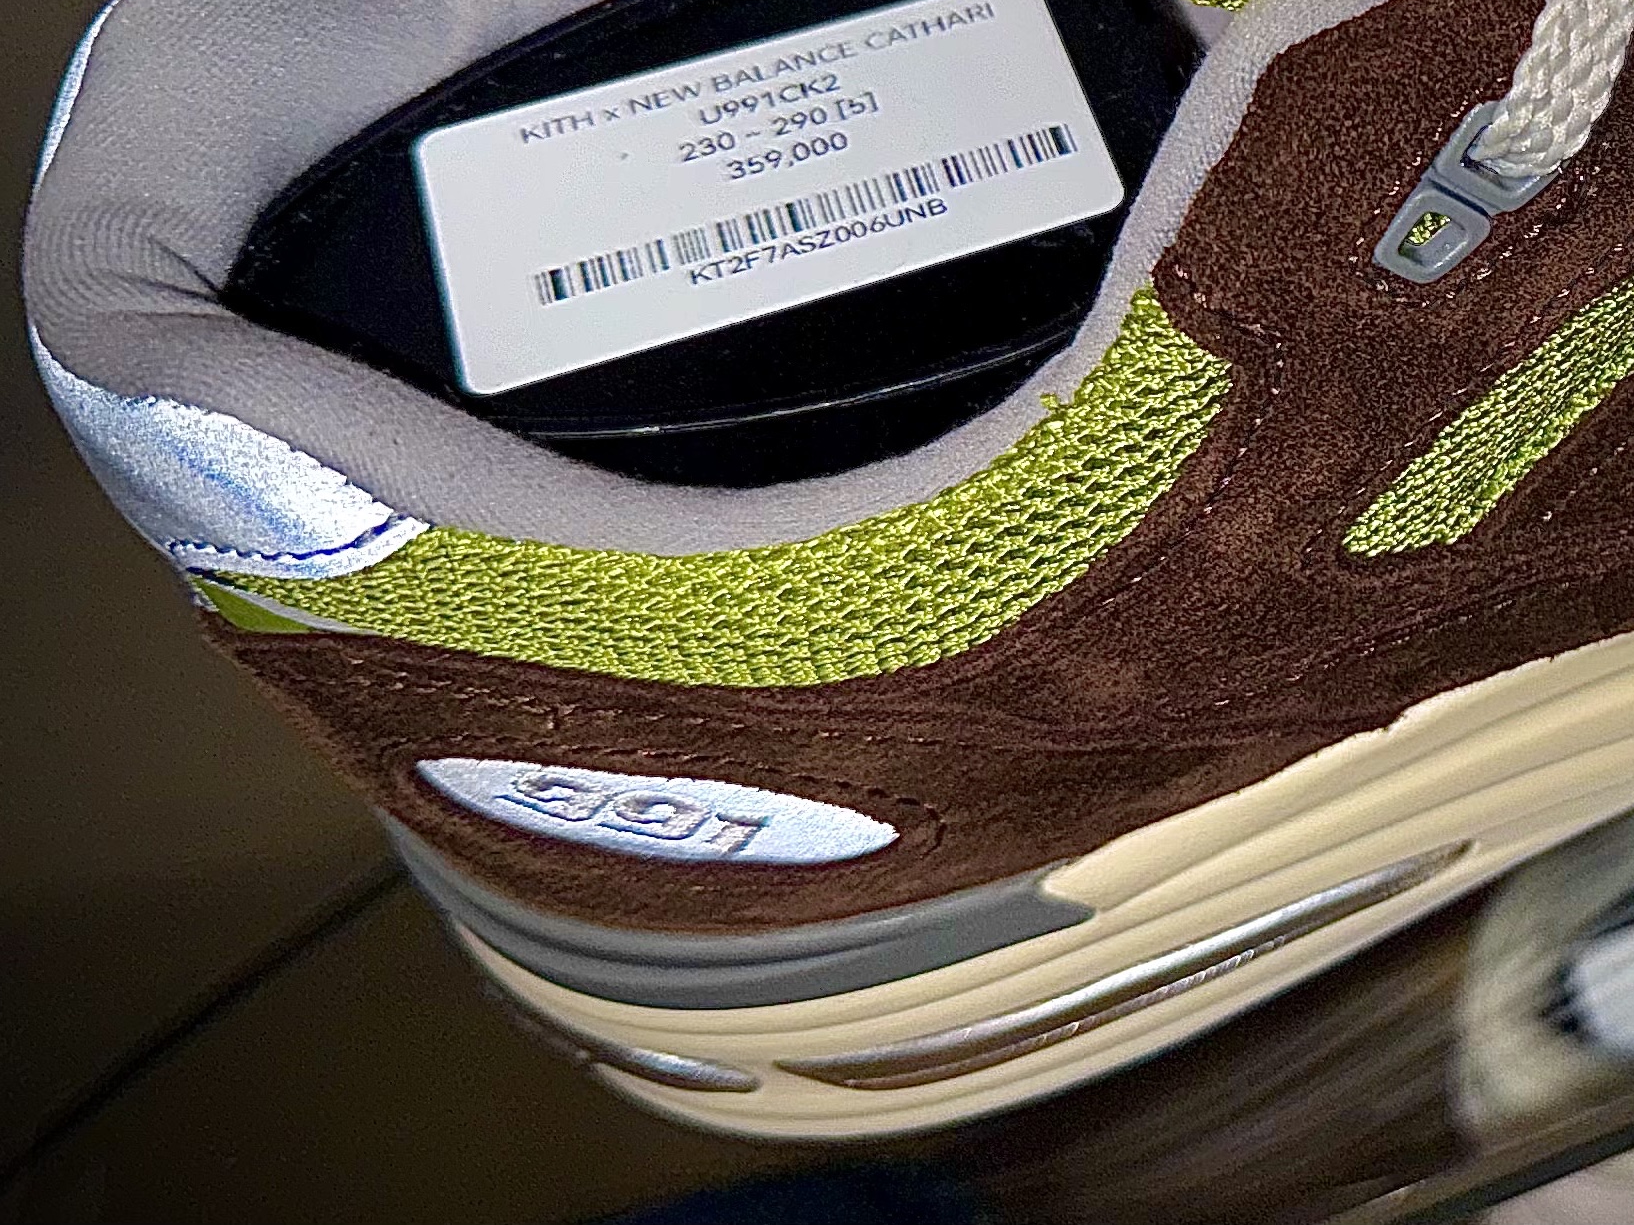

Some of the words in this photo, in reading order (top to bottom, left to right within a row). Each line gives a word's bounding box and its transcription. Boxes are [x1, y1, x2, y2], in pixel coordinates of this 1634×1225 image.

[520, 110, 596, 143] KITH
[628, 81, 702, 115] NEW
[710, 40, 858, 93] BALANCE
[864, 1, 996, 50] CATHARI
[699, 74, 841, 125] U991CK2
[679, 131, 736, 163] 230
[772, 106, 828, 136] 290
[726, 131, 849, 180] 359,000
[689, 198, 949, 286] KT2F7ASZ006UNB
[494, 766, 773, 856] 991
